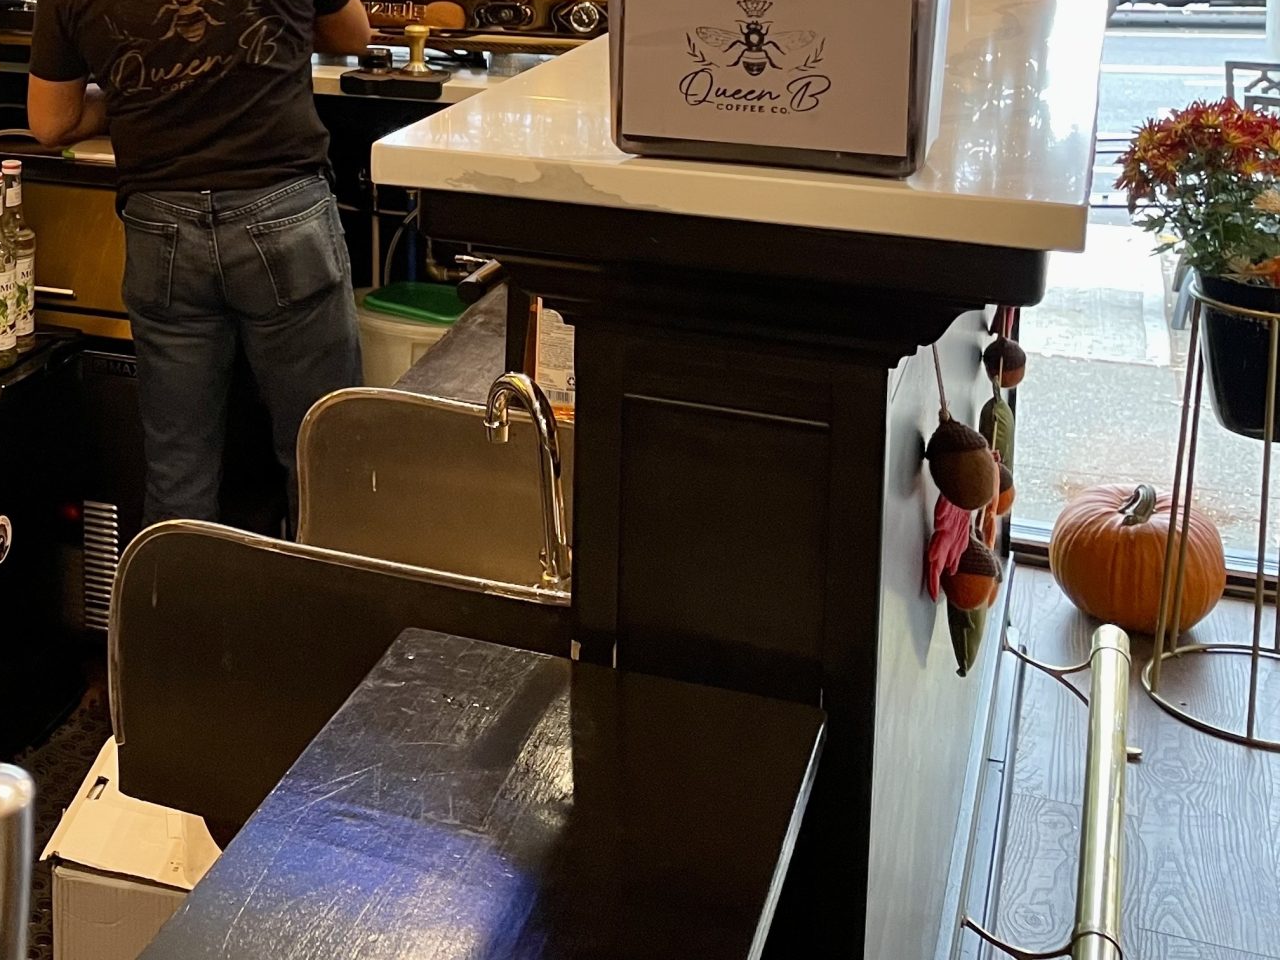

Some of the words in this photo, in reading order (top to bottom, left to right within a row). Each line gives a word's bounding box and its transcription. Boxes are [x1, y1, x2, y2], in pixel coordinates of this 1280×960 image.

[110, 49, 232, 96] Queen
[238, 15, 286, 65] B
[679, 67, 780, 106] Queen
[786, 74, 831, 112] B
[716, 103, 765, 113] COFFEE
[771, 106, 791, 115] CO.
